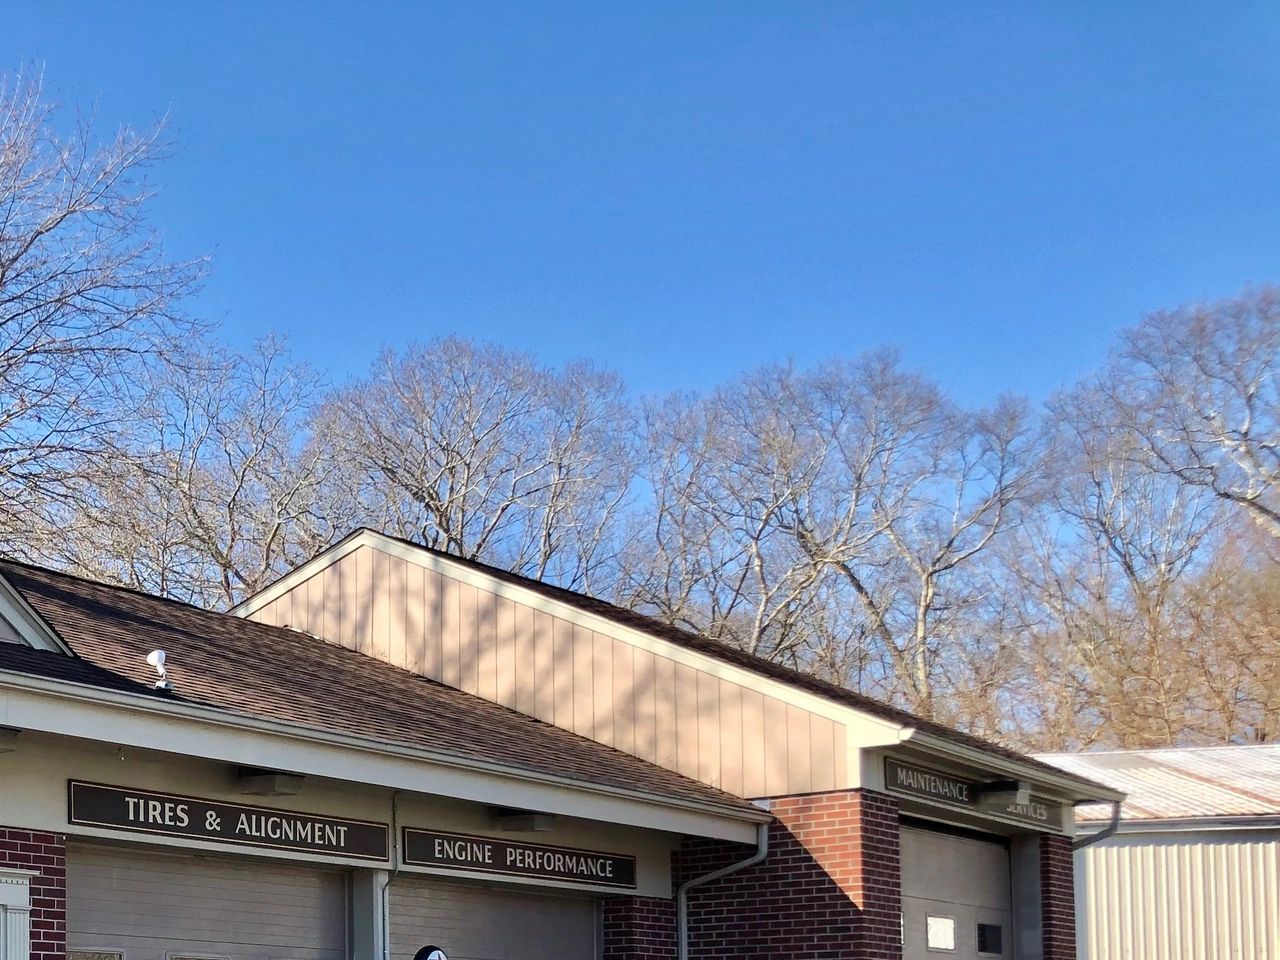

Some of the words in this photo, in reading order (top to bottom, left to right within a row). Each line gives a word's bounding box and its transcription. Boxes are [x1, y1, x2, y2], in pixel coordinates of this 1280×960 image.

[896, 766, 970, 802] MAINTENANCE
[124, 796, 190, 828] TIRES
[205, 810, 222, 832] &
[234, 812, 349, 848] ALIGNMENT
[433, 838, 494, 865] ENGINE
[506, 848, 615, 879] PERFORMANCE
